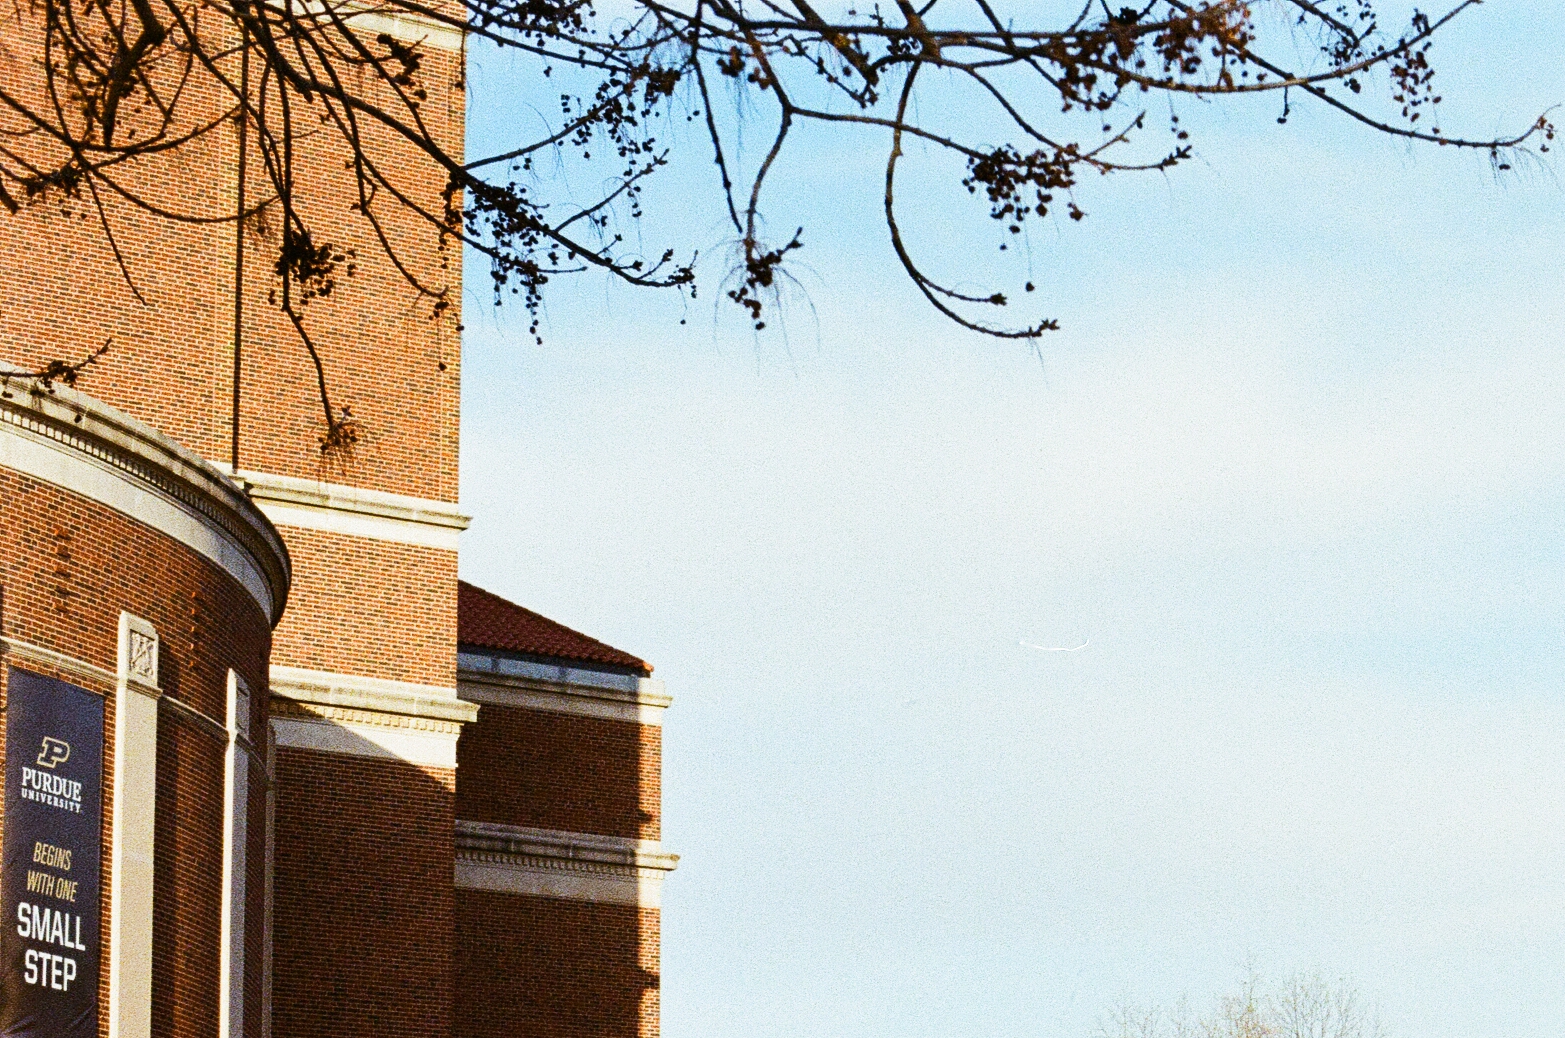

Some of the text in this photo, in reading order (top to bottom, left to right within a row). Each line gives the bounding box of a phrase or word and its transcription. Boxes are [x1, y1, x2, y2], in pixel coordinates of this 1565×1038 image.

[21, 787, 82, 814] UNIVERSITY
[22, 766, 82, 802] PURDUE
[32, 841, 72, 871] BEGINS
[26, 869, 79, 903] WITH ONE
[17, 901, 86, 951] SMALL
[24, 949, 77, 992] STEP
